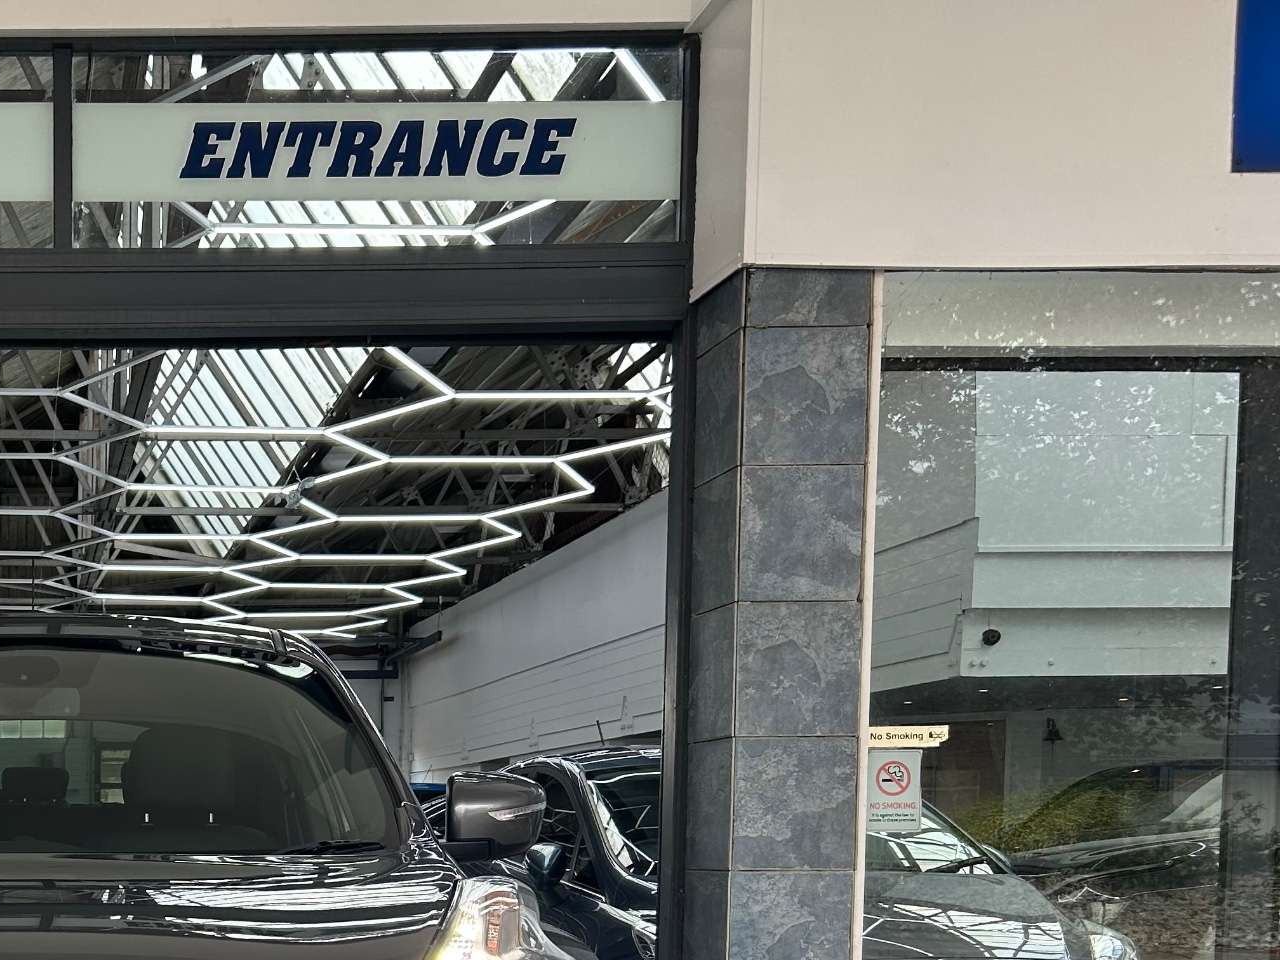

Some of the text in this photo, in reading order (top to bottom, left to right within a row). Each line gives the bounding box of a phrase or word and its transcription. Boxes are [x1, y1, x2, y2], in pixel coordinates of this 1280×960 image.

[179, 117, 578, 179] ENTRANCE
[870, 731, 924, 741] No Smoking
[870, 801, 880, 810] NO
